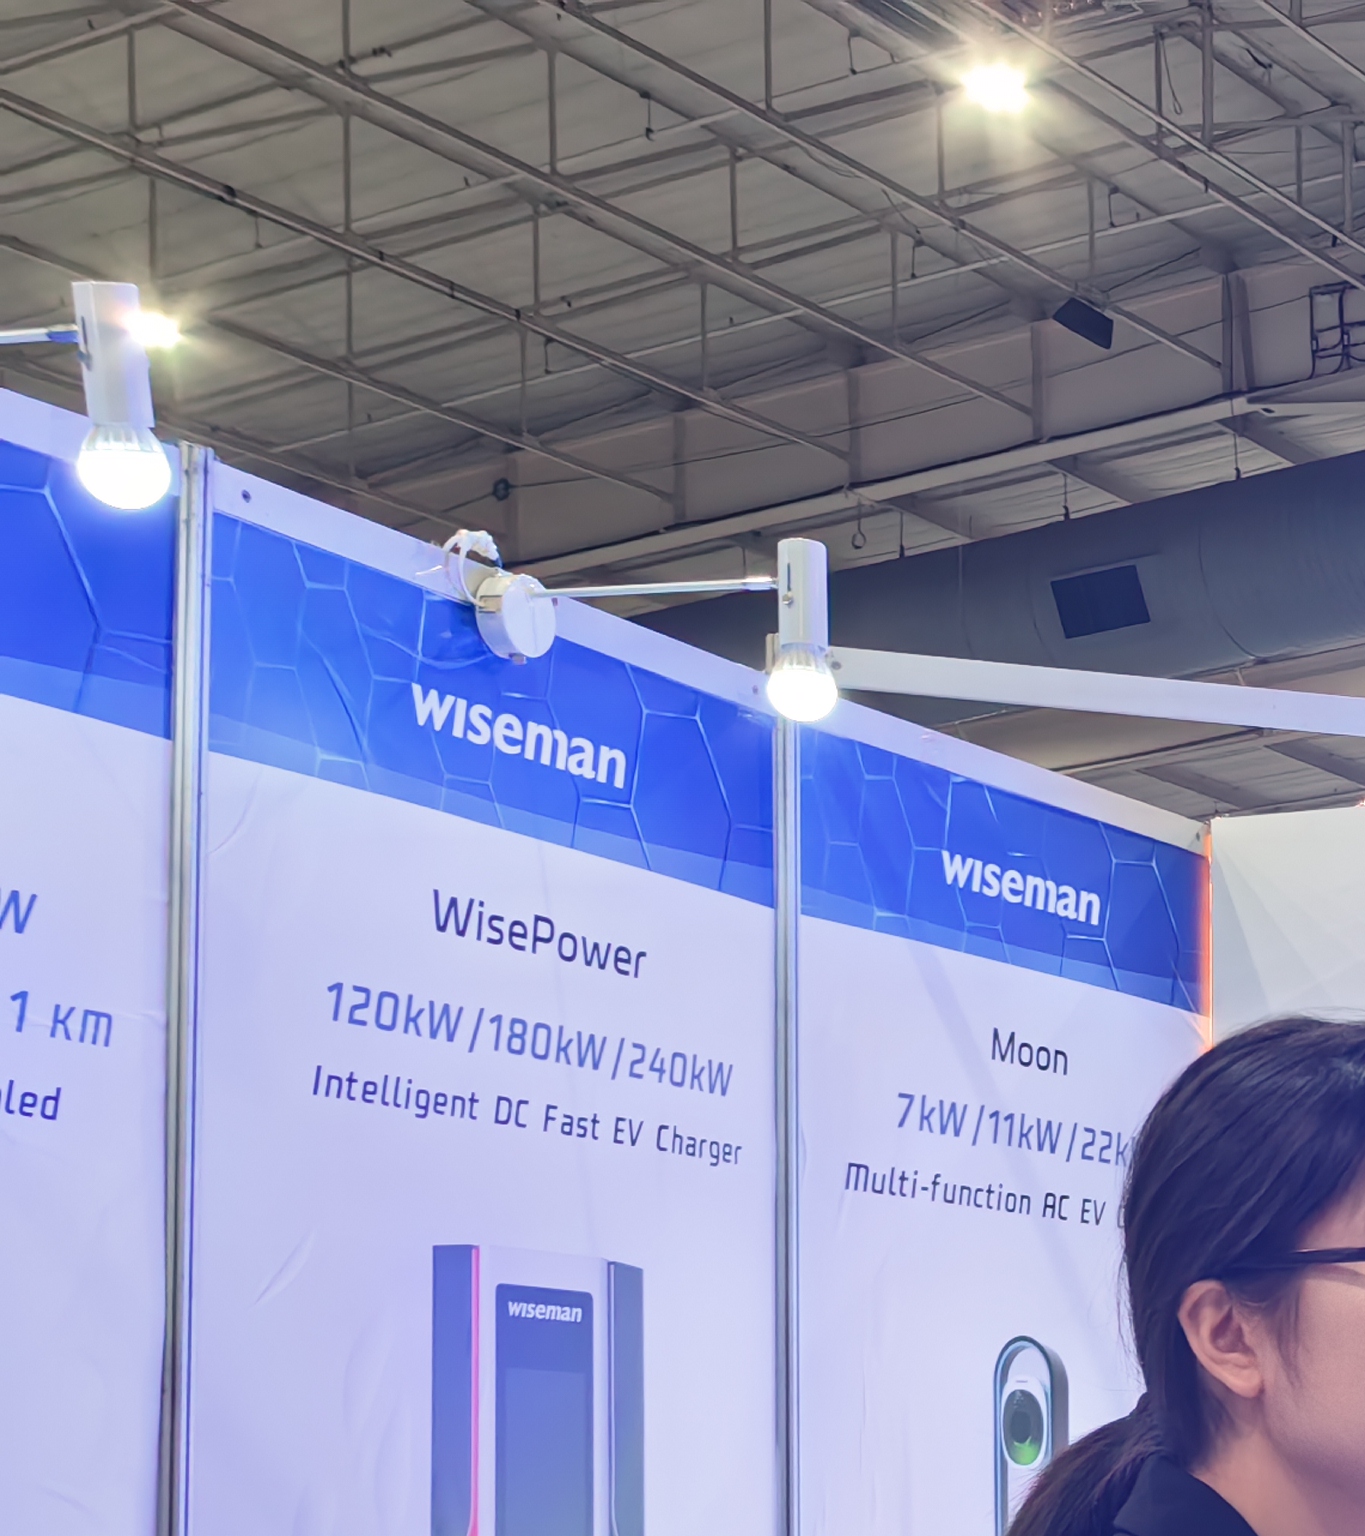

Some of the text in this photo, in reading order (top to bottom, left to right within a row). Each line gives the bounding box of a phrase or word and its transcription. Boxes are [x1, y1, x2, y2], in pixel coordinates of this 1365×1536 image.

[411, 683, 626, 788] wiseman
[941, 850, 1100, 926] wiseman
[432, 888, 647, 979] WisePower
[10, 991, 28, 1032] 1
[992, 1028, 1068, 1075] Moon
[0, 1080, 62, 1120] led
[312, 1065, 742, 1166] Intelligent DC Fast EV Charger
[845, 1162, 1106, 1226] Multi-function AC EV
[508, 1301, 582, 1322] wiseman
